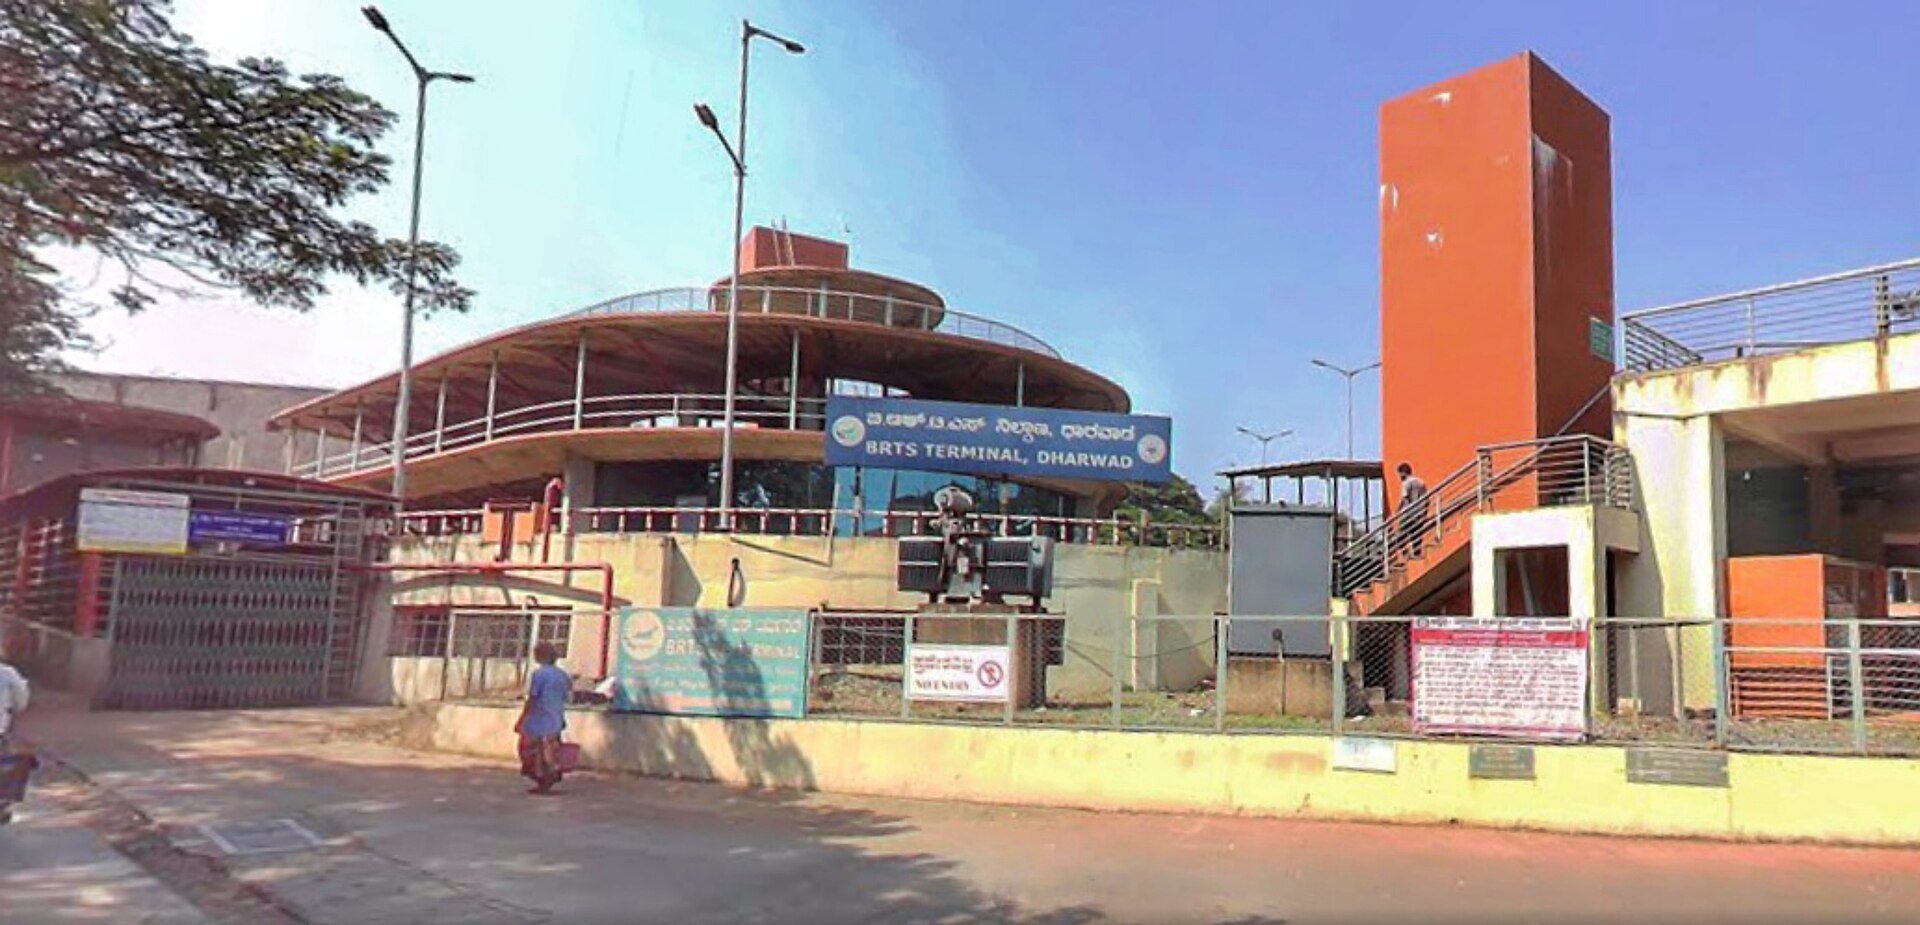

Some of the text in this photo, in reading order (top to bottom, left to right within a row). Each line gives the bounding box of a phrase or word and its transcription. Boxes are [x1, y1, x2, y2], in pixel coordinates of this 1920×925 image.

[865, 440, 1133, 469] BRTS TERMINAL, DHARWAD
